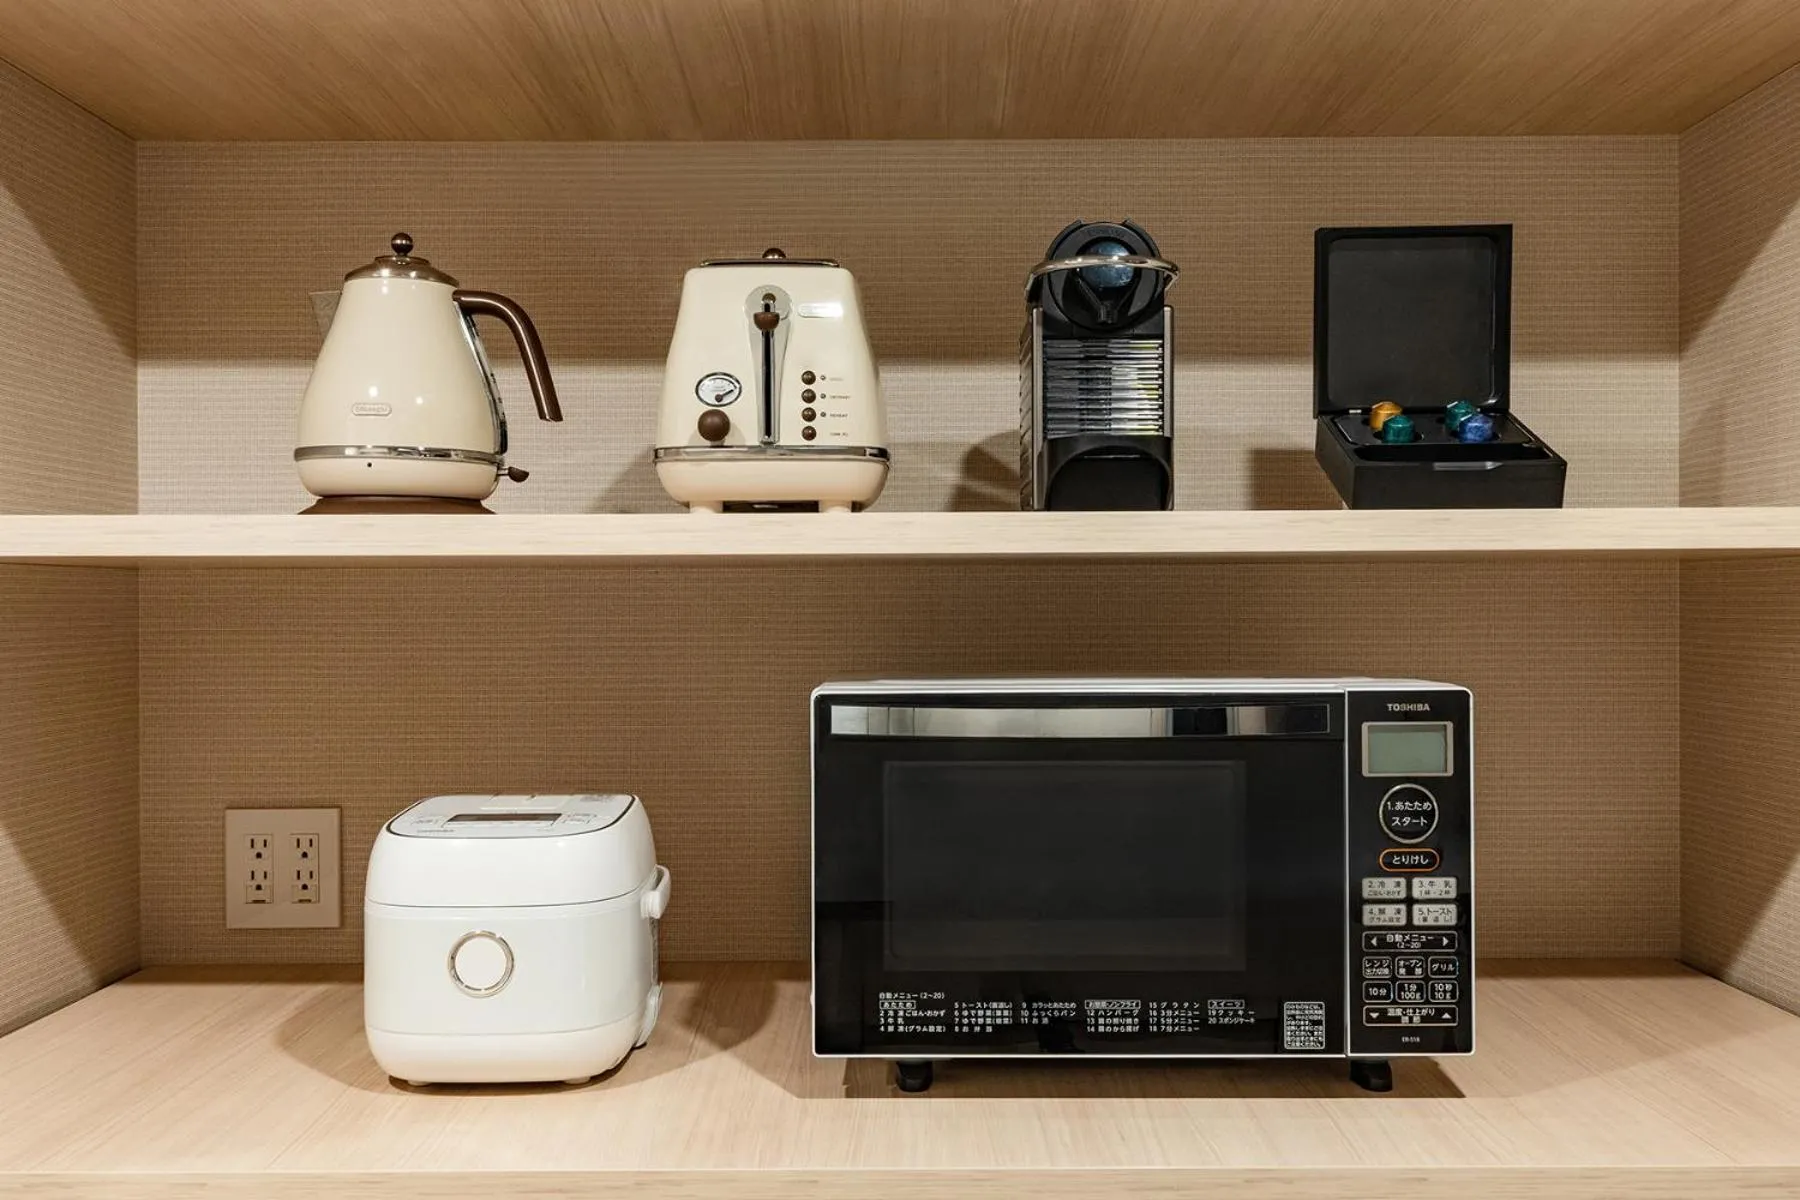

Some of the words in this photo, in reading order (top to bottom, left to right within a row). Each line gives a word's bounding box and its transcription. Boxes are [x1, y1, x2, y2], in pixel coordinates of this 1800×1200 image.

[1387, 703, 1430, 711] TOSHIBA
[1386, 800, 1432, 811] 1.あたため
[1392, 816, 1427, 826] スタート
[1393, 855, 1428, 864] とりけし
[1418, 907, 1453, 916] 5.トースト
[1386, 934, 1436, 942] 自動メニュー
[1432, 963, 1455, 971] グリル
[1368, 988, 1387, 997] 10分
